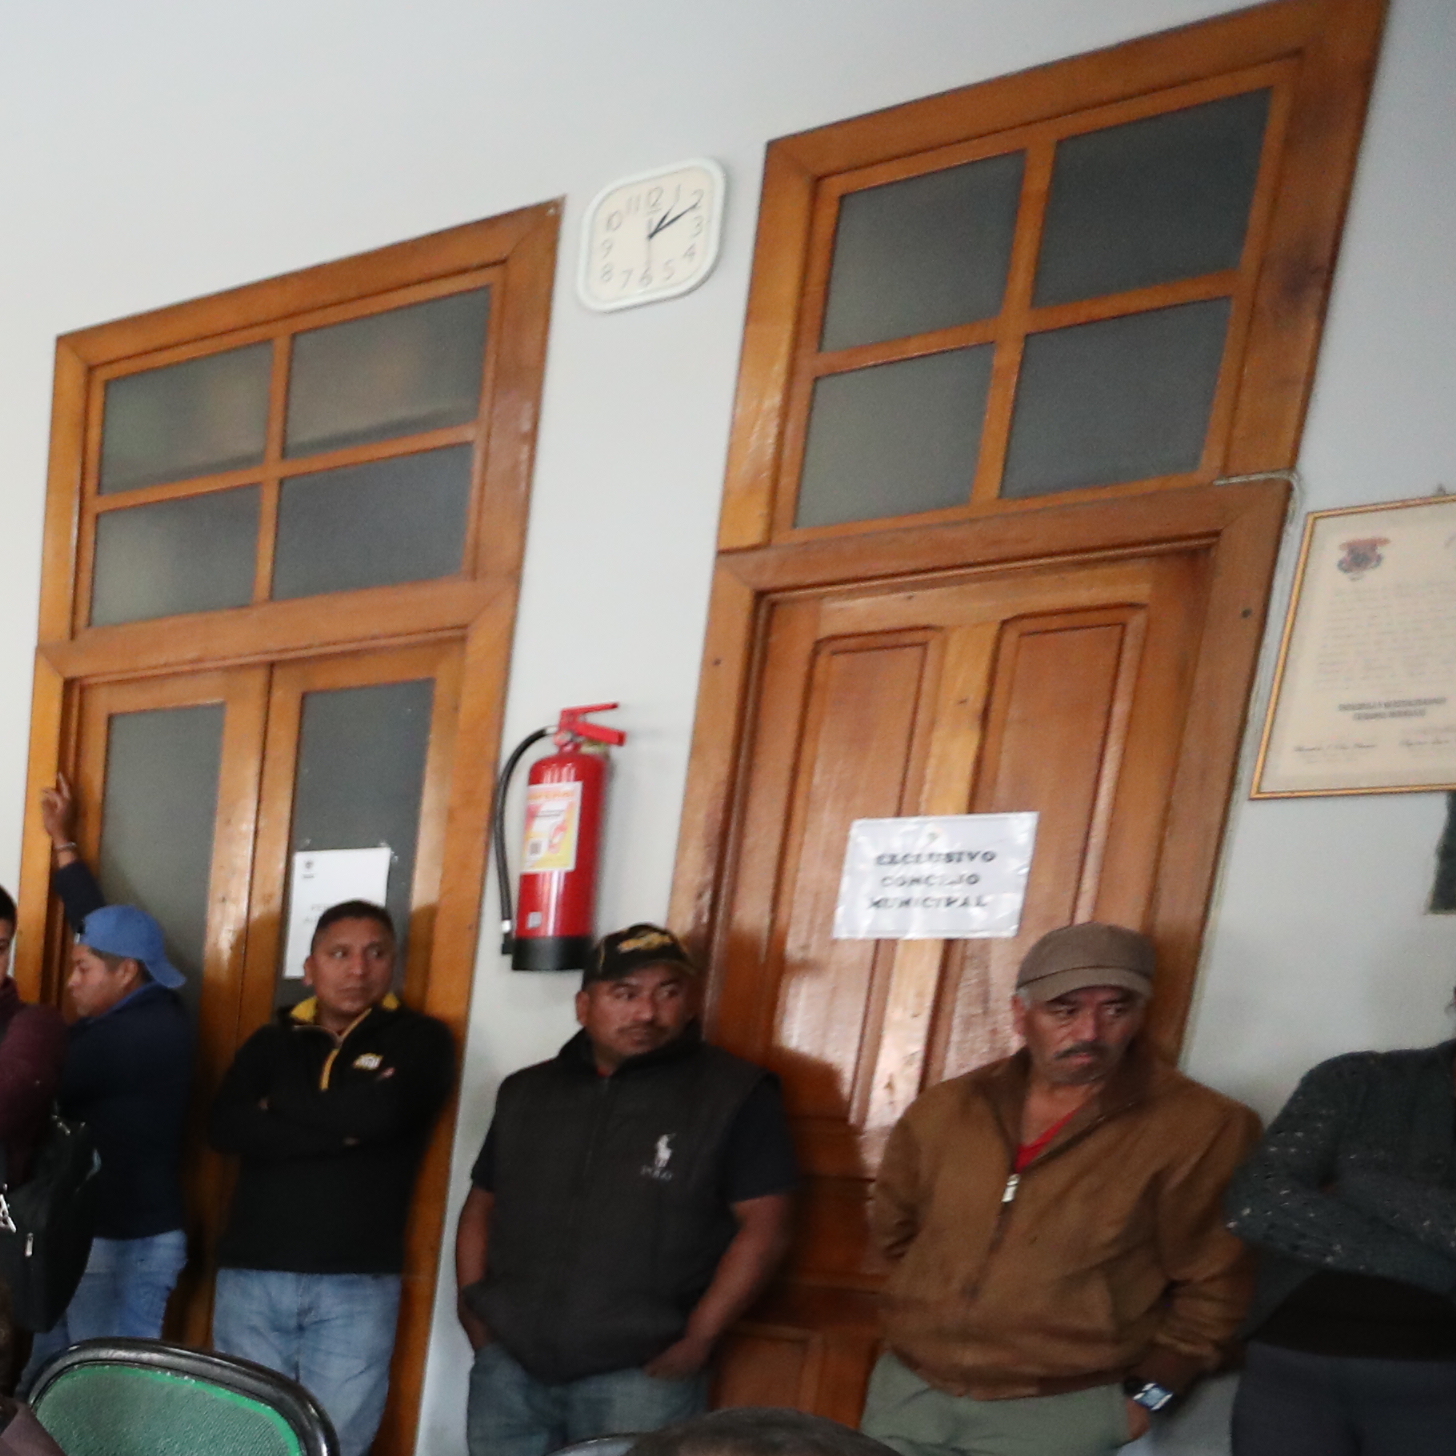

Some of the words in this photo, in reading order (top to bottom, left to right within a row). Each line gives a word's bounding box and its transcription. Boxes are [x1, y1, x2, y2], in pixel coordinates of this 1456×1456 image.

[691, 214, 705, 239] 3
[600, 237, 614, 259] 9
[682, 242, 697, 263] 4
[600, 262, 614, 283] 8
[621, 268, 634, 290] 7
[639, 266, 653, 288] 6
[663, 258, 676, 281] 5
[876, 850, 997, 866] EXCLUSIVO
[868, 895, 989, 909] MUNICIPAL
